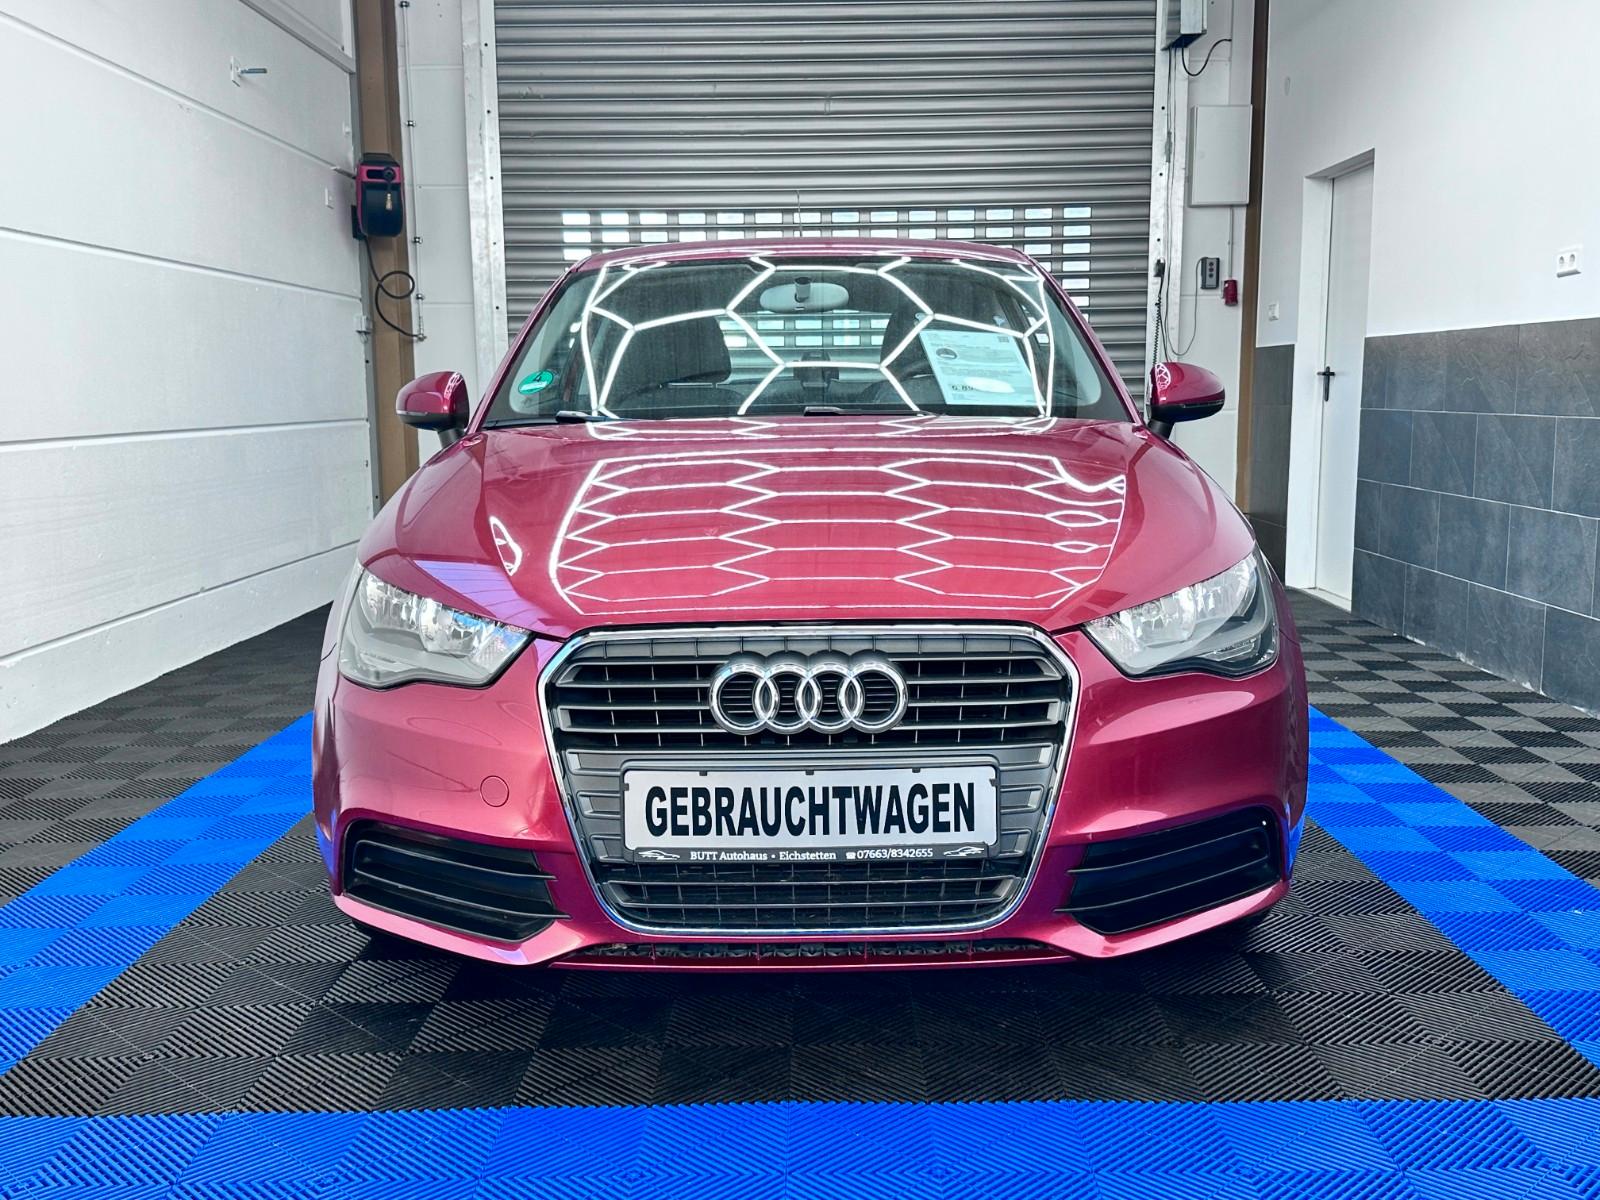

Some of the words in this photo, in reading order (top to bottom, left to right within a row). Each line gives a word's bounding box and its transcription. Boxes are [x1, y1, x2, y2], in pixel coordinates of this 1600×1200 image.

[645, 782, 975, 837] GEBRAUCHTWAGEN
[690, 851, 718, 861] BUTT
[719, 851, 768, 861] Autohaus
[779, 850, 836, 861] Eichstetten
[857, 848, 934, 860] 07663/8342655
